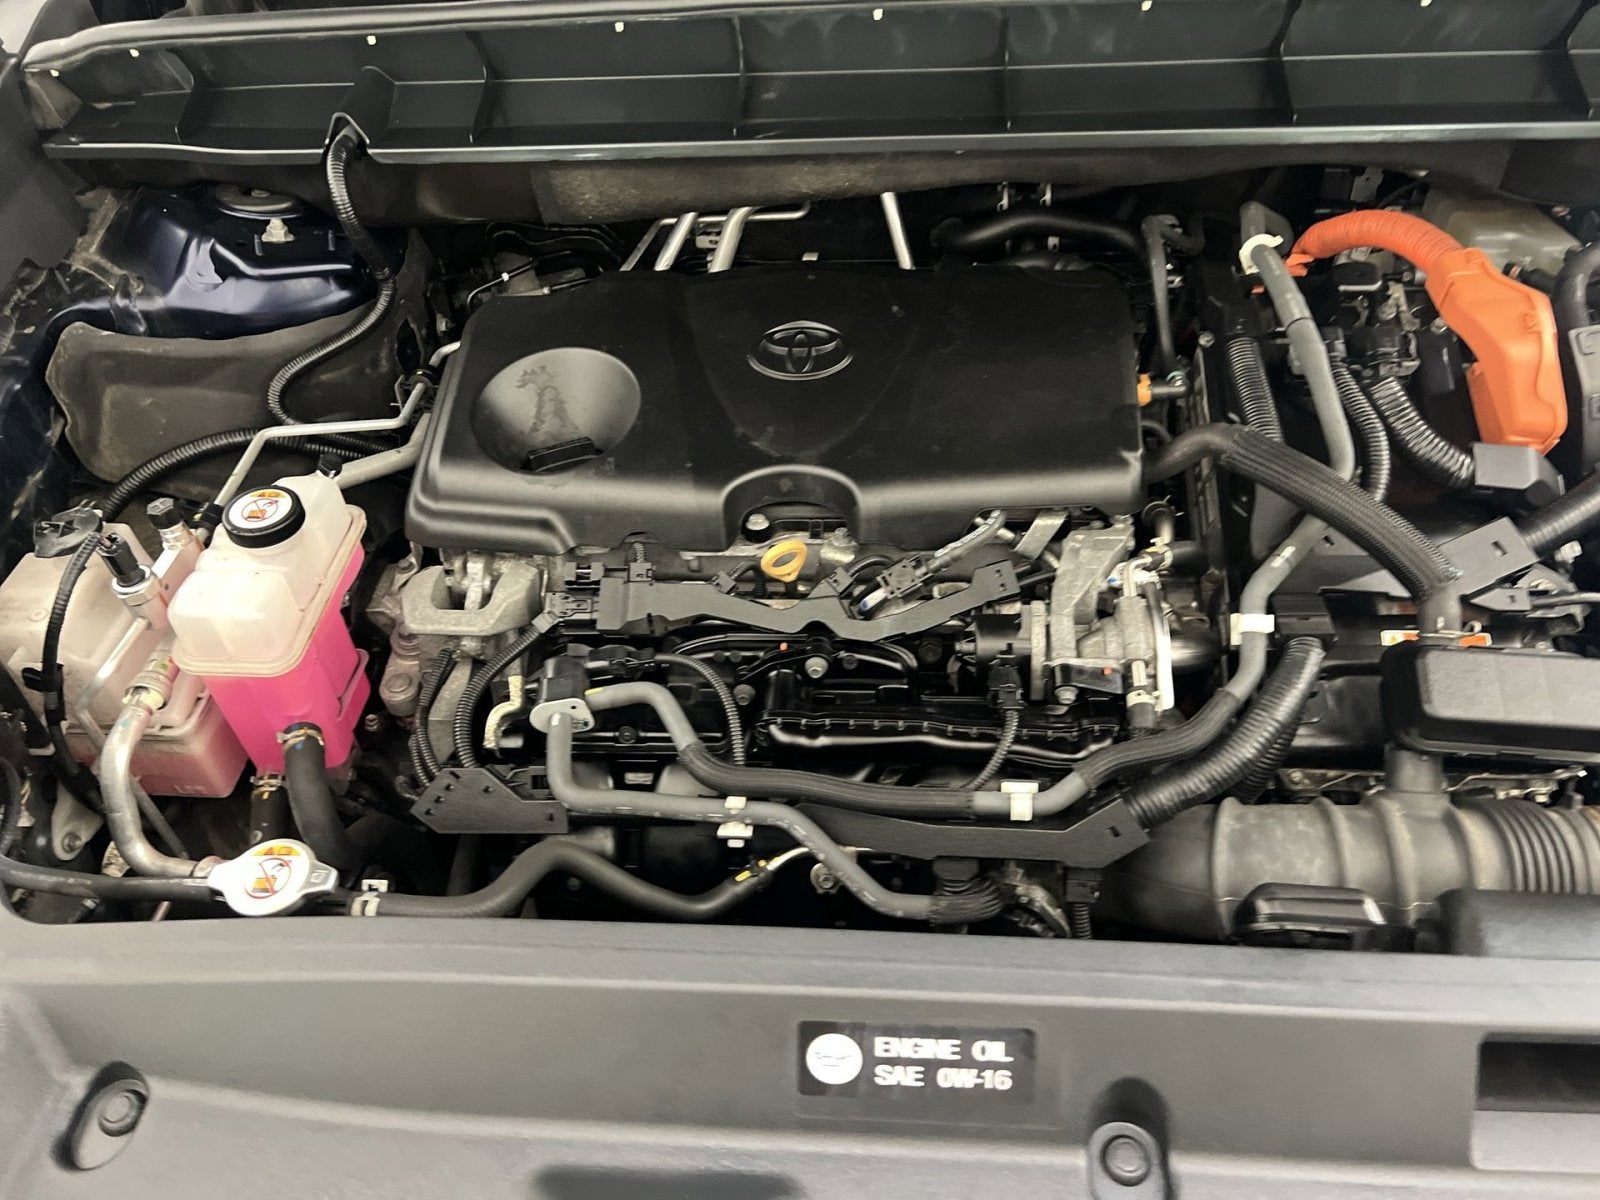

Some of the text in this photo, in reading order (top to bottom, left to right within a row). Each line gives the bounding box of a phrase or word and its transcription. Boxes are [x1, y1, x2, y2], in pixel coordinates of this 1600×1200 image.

[874, 1036, 1015, 1062] ENGINE OIL
[874, 1064, 1013, 1090] SAE 0W-16
